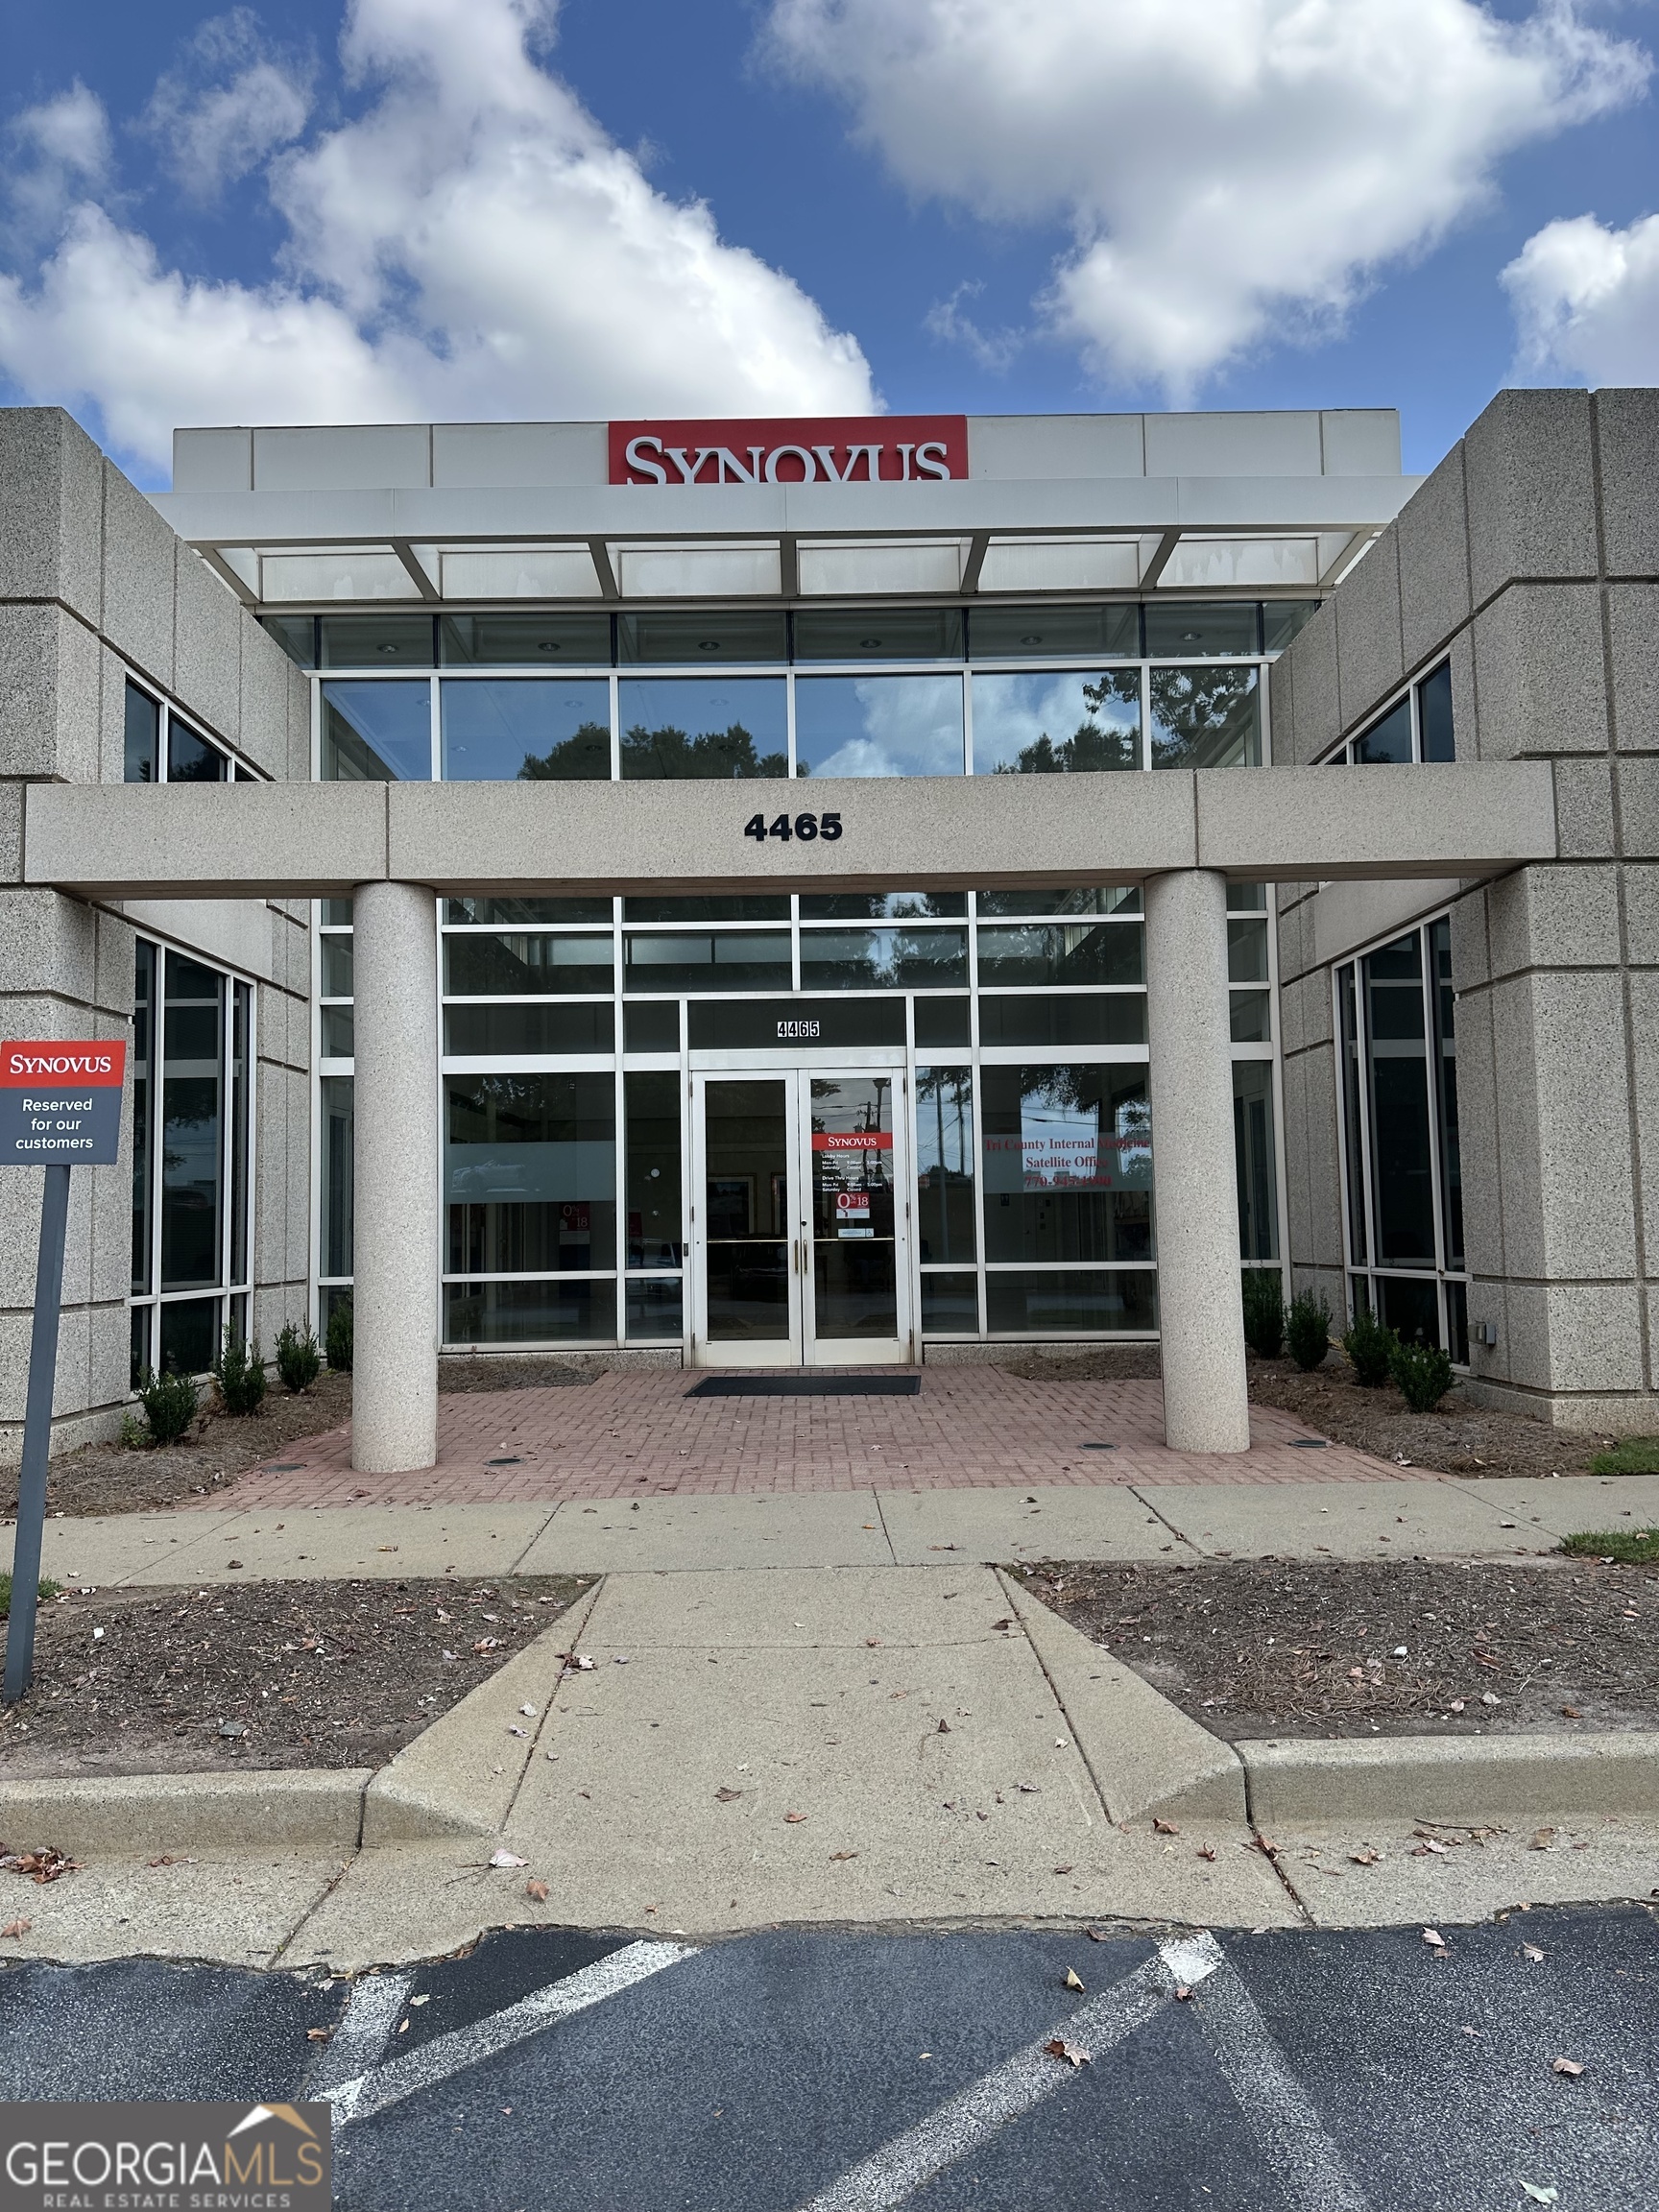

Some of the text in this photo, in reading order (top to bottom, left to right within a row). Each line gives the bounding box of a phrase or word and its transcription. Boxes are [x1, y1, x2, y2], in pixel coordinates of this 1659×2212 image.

[626, 436, 951, 485] SYNOVUS
[744, 813, 843, 841] 4465
[778, 1022, 819, 1037] 4465
[10, 1054, 111, 1074] SYNOVUS
[22, 1098, 93, 1112] Reserved
[31, 1118, 82, 1131] for our
[15, 1138, 93, 1149] customers
[828, 1137, 877, 1146] SYNOVUS
[985, 1137, 1150, 1152] Tri County Internal Medicine
[1025, 1155, 1108, 1168] Satellite Office
[857, 1196, 869, 1206] 18
[577, 1217, 588, 1227] 18
